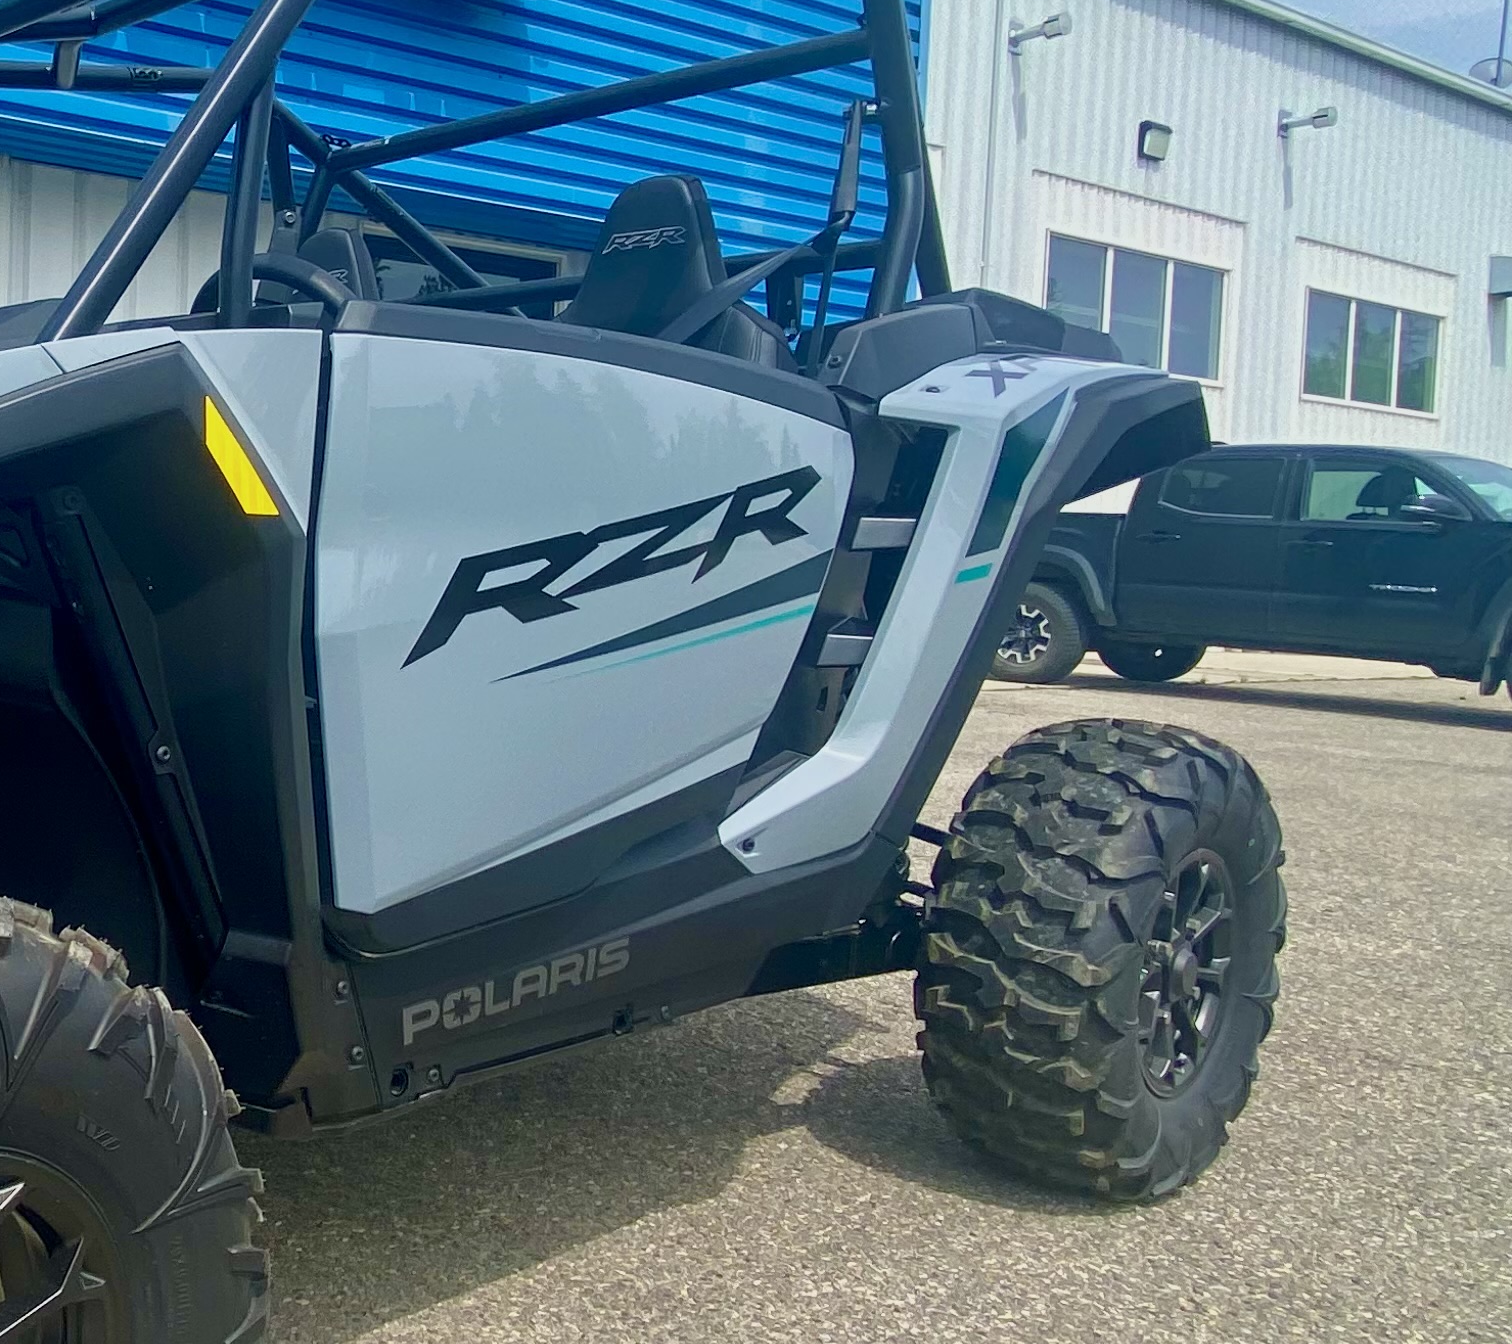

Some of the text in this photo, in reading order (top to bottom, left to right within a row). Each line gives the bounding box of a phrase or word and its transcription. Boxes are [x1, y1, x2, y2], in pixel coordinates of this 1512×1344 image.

[601, 225, 686, 255] RZR
[400, 465, 821, 670] RZR
[402, 935, 630, 1046] POLARIS
